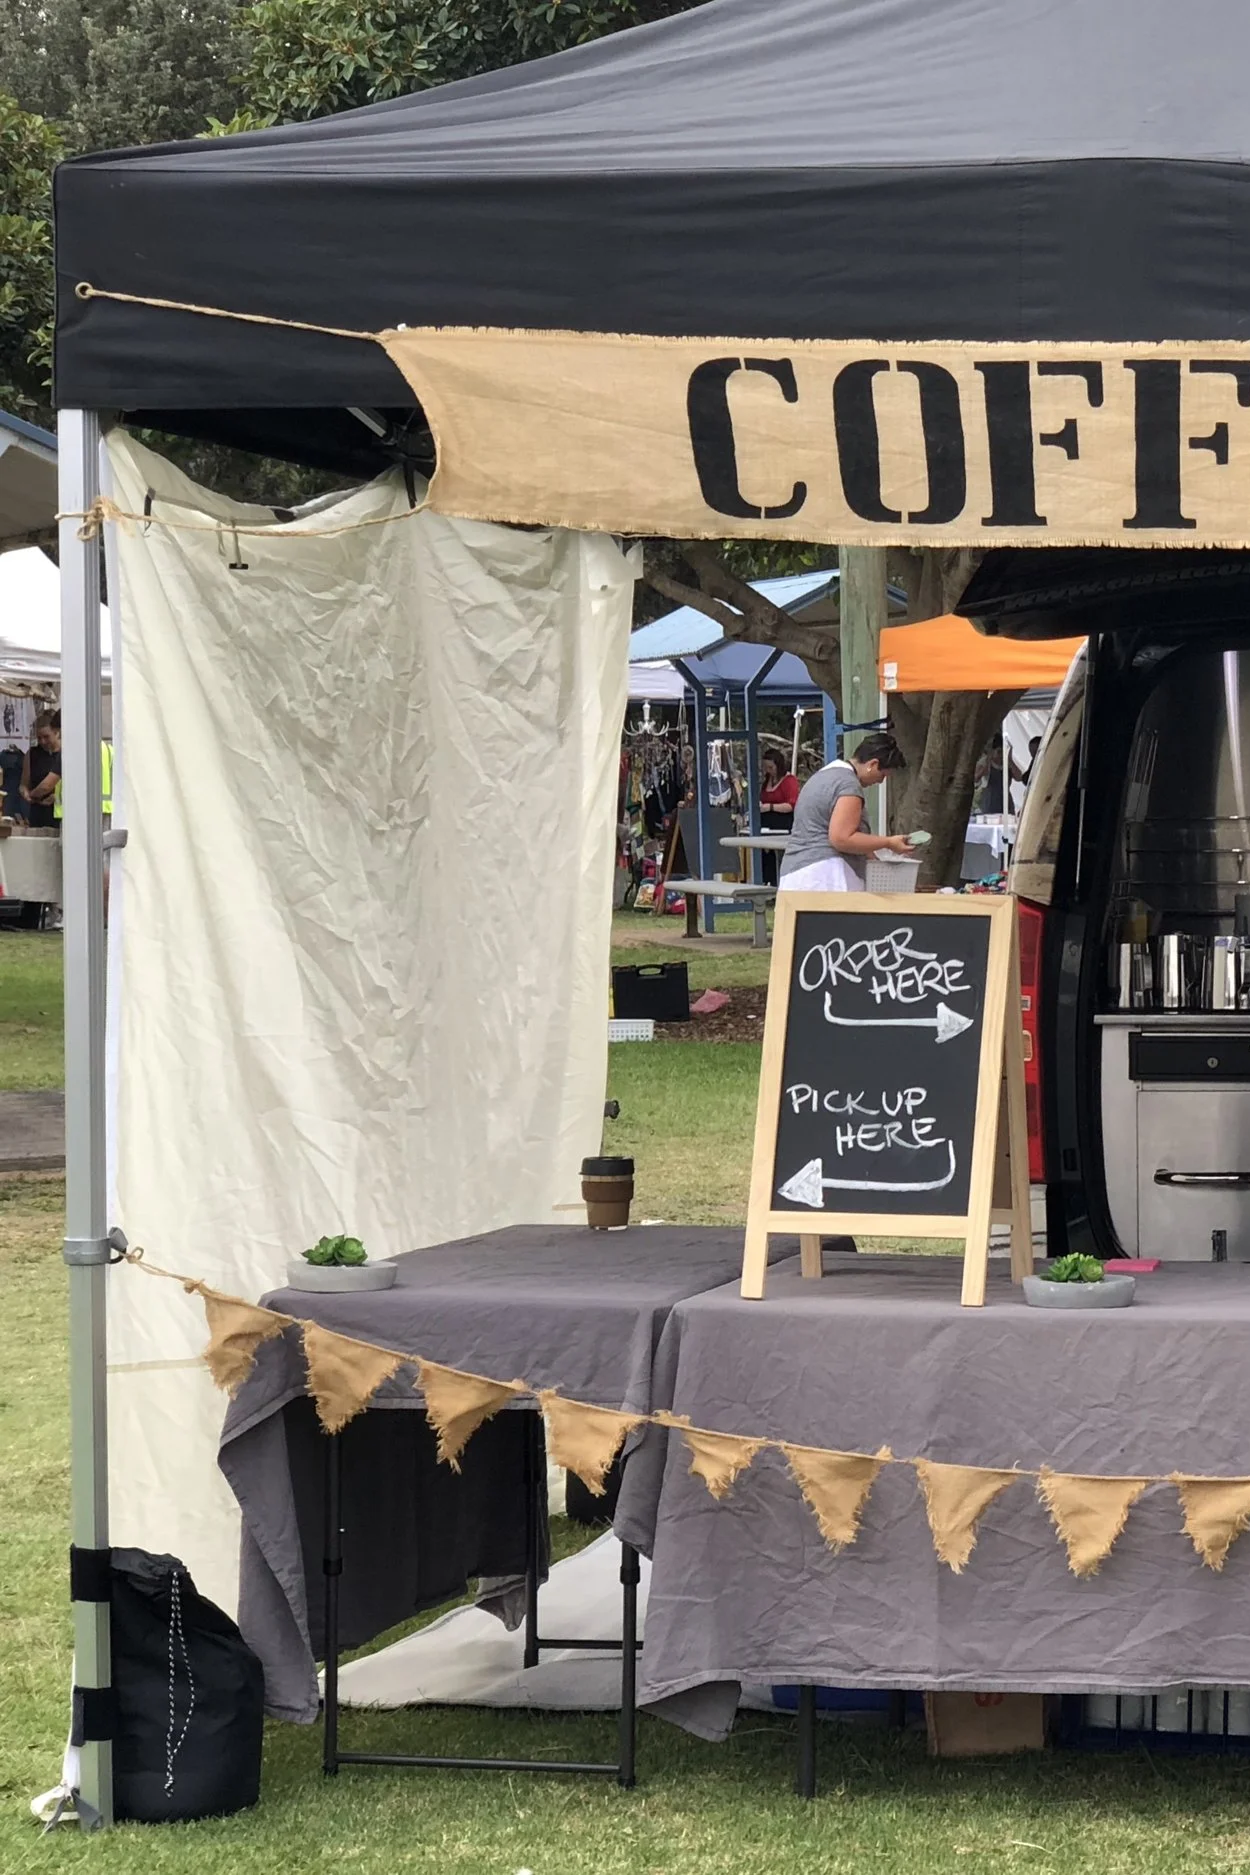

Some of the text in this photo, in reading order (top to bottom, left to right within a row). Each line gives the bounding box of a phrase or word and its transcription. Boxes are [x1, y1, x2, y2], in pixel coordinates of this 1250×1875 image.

[799, 927, 938, 992] ORDER
[868, 959, 972, 1004] HERE
[785, 1083, 928, 1116] PICK UP
[835, 1117, 946, 1157] HERE
